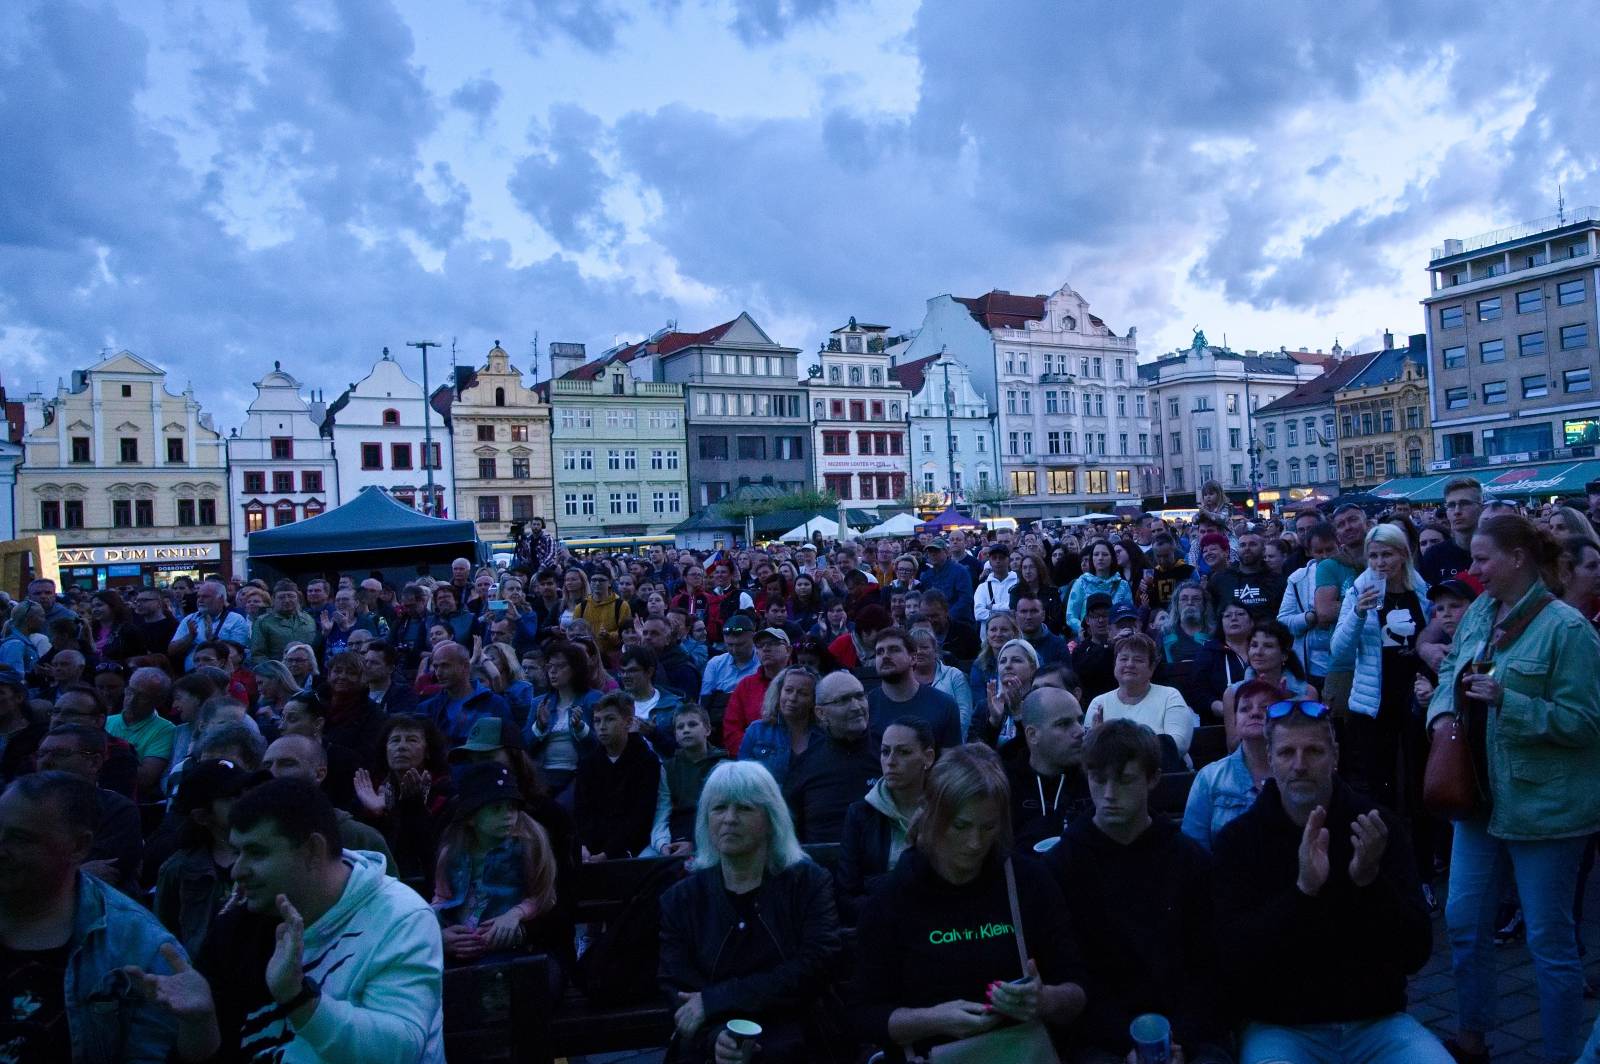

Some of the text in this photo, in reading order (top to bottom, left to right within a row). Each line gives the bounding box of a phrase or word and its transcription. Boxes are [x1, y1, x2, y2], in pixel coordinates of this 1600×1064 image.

[105, 547, 211, 561] DŮM KNIHY
[980, 921, 1016, 940] Klein
